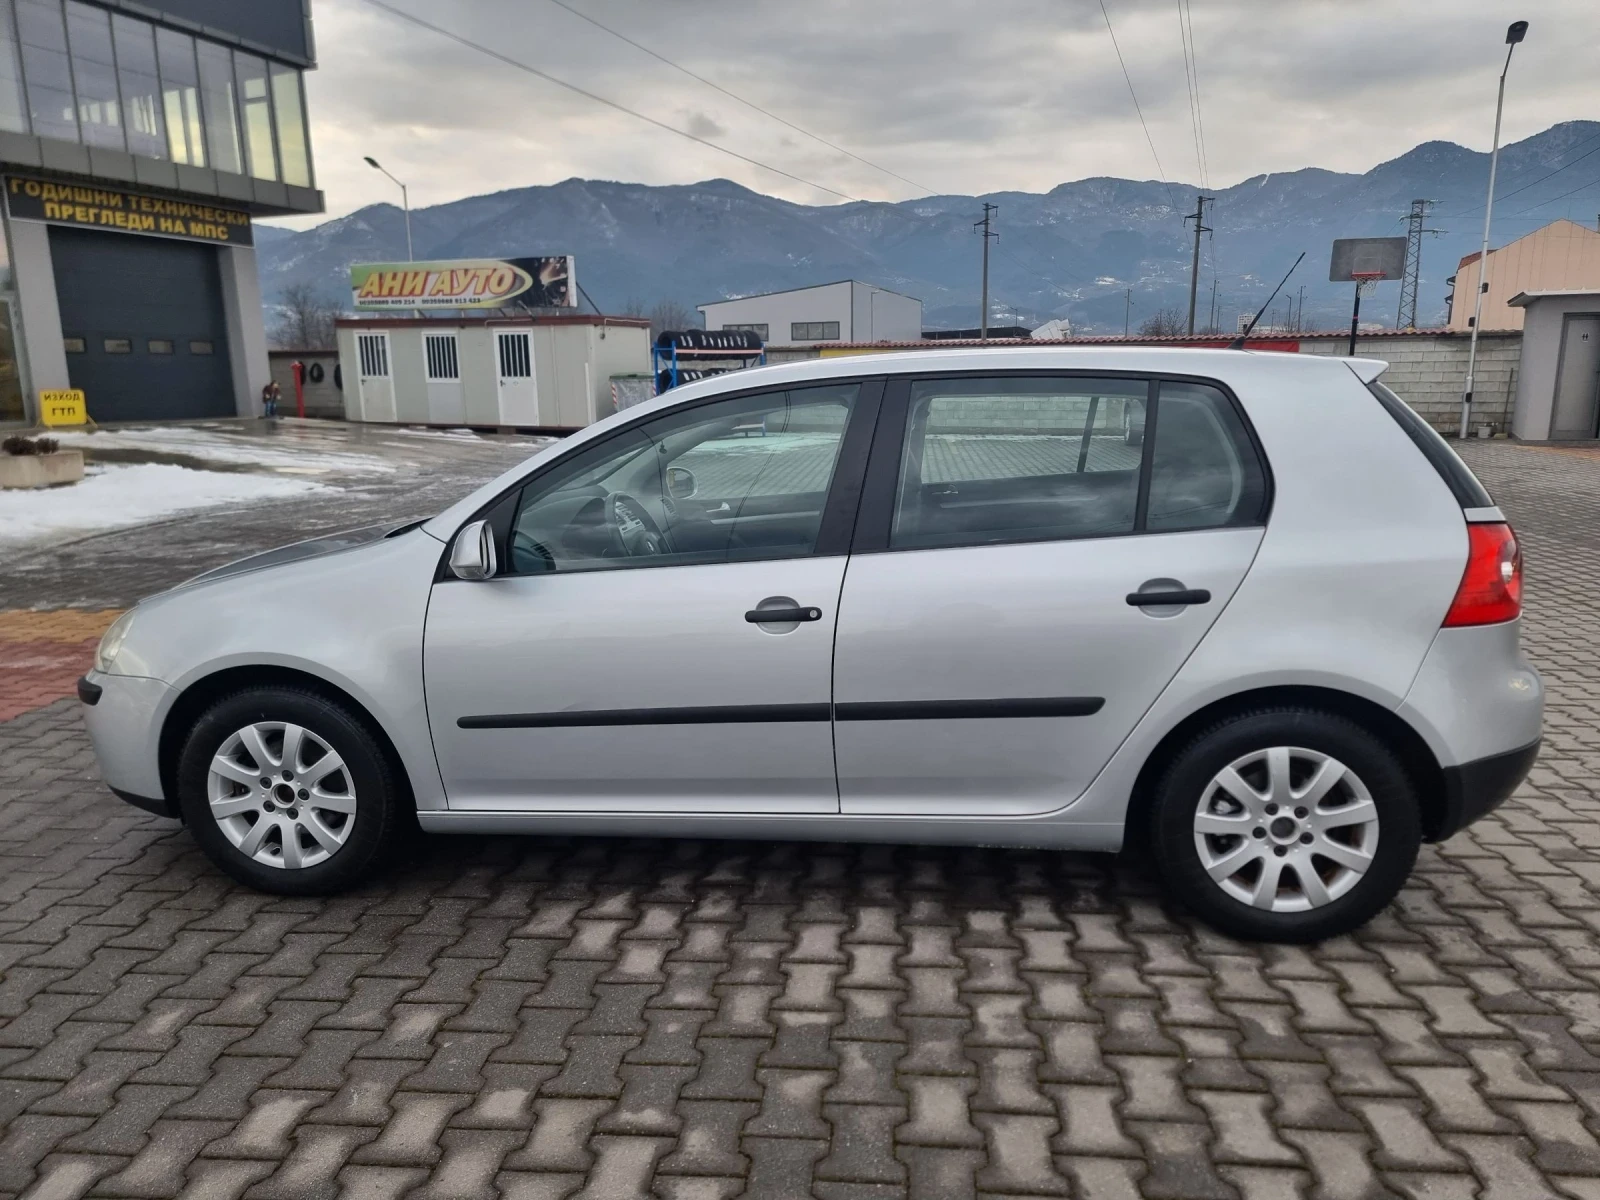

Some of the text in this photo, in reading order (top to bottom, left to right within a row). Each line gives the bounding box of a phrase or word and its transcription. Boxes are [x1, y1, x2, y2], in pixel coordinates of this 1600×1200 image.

[10, 178, 249, 227] ГОДИШНИ ТЕХНИЧЕСКИ
[45, 203, 229, 241] ПРЕГЛЕДИ НА МПС
[359, 268, 516, 298] АНИ АУТО
[44, 393, 80, 401] ИЗХОД
[52, 407, 76, 416] ГТП
